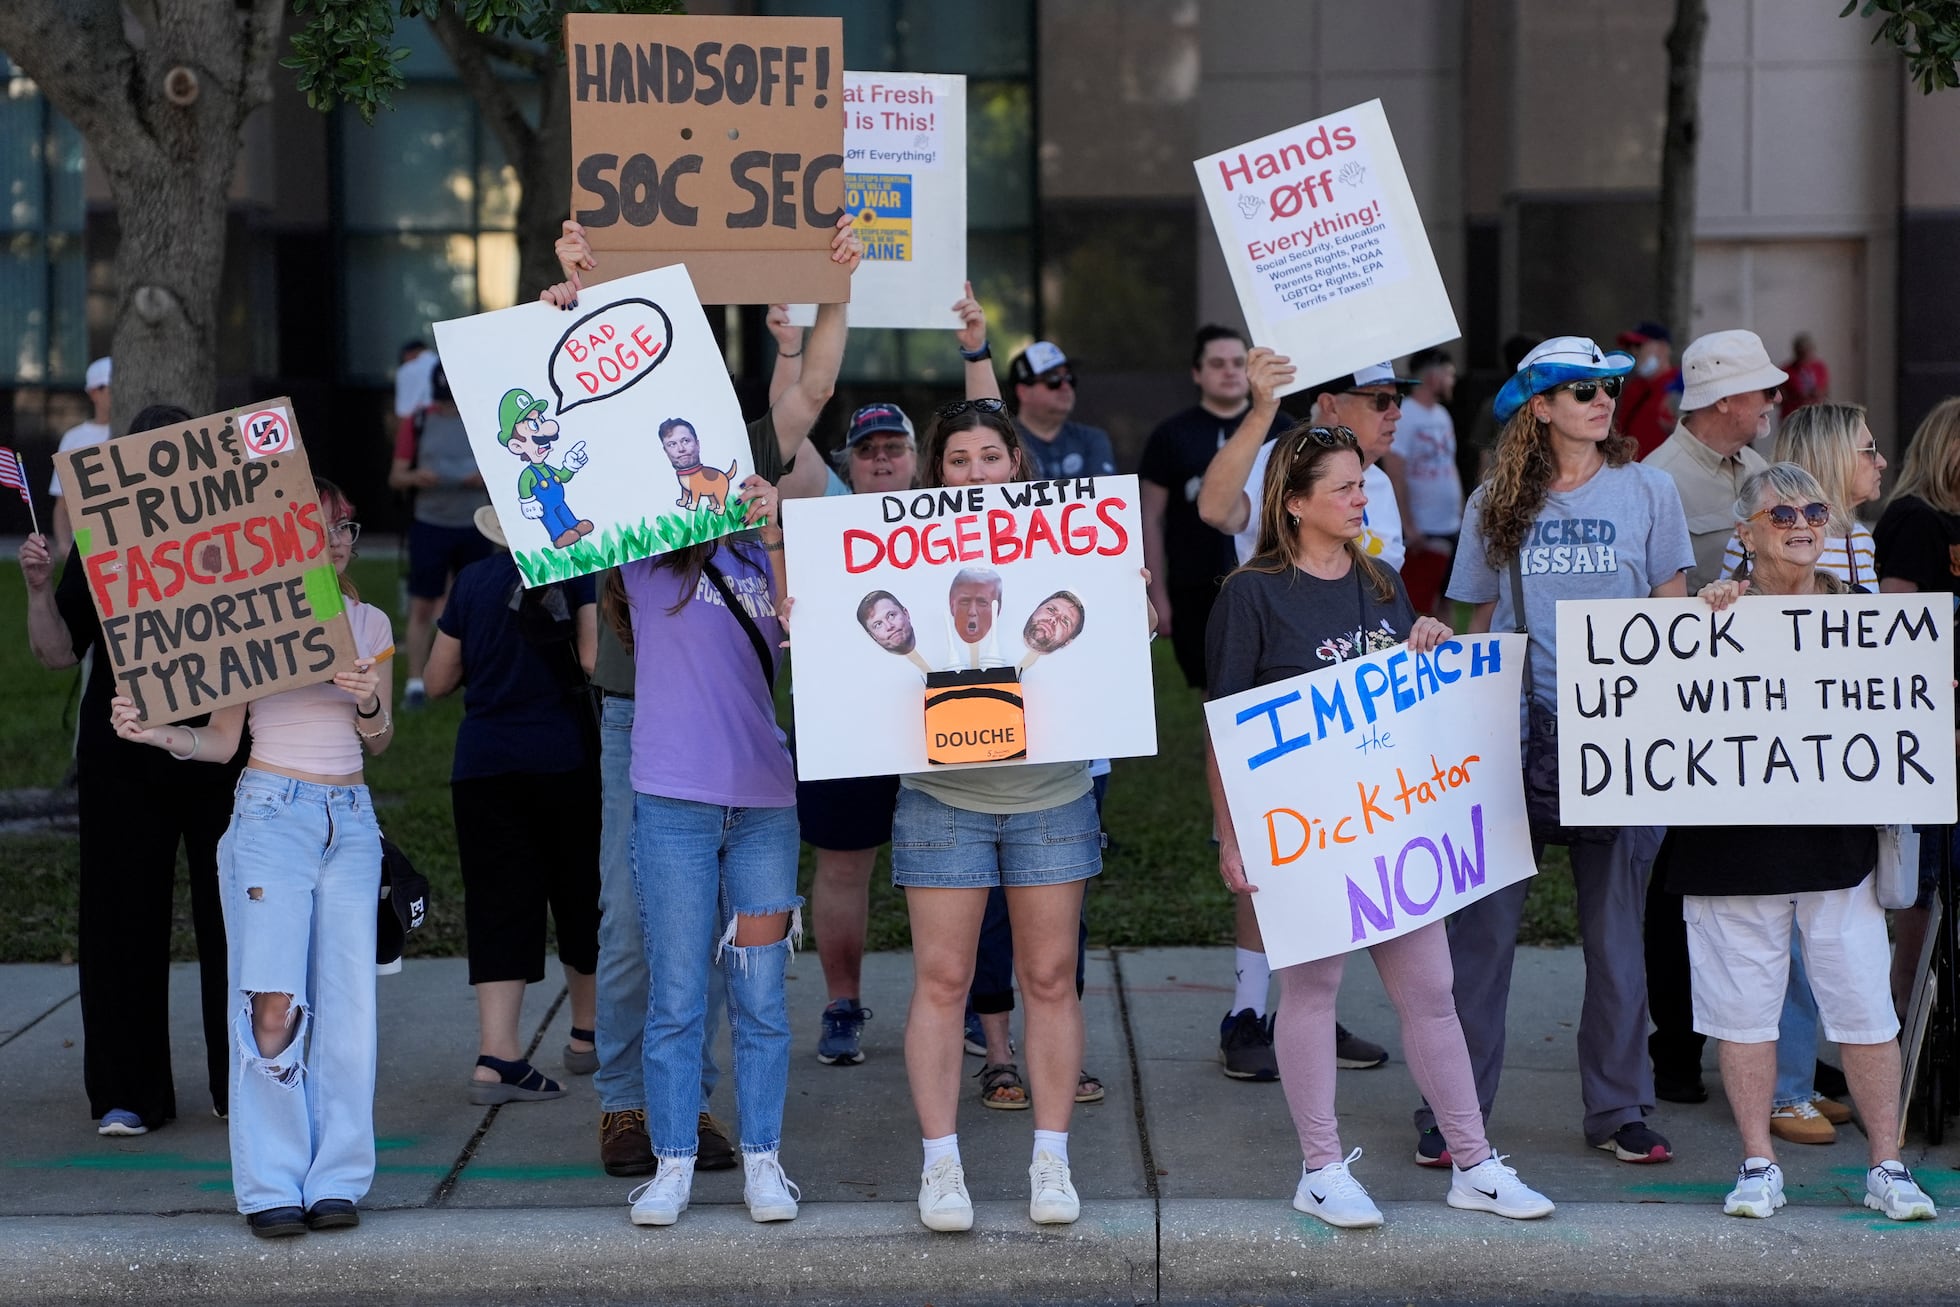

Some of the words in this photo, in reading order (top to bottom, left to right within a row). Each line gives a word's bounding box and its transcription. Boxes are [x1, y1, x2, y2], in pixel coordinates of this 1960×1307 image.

[843, 85, 864, 103] at
[871, 84, 934, 104] Fresh
[856, 111, 873, 130] is
[881, 112, 935, 131] This!
[870, 150, 936, 163] Everything!
[1218, 125, 1357, 192] Hands
[576, 153, 703, 228] SOC
[726, 150, 846, 229] SEC
[846, 190, 860, 208] O
[863, 190, 901, 208] WAR
[1247, 200, 1382, 261] Everything!
[1256, 254, 1288, 273] Social
[1288, 242, 1334, 262] Security,
[1334, 223, 1386, 246] Education
[1269, 262, 1313, 281] Womens
[1313, 248, 1350, 266] Rights,
[1350, 237, 1380, 253] Parks
[1274, 274, 1313, 292] Parents
[1314, 261, 1351, 279] Rights,
[1351, 248, 1383, 265] NOAA
[1281, 283, 1323, 303] LGBTQ+
[1325, 270, 1361, 288] Rights,
[1362, 261, 1384, 275] EPA
[1337, 276, 1374, 296] Taxes!!
[564, 324, 615, 363] BAD
[576, 324, 663, 394] DOGE
[70, 428, 217, 500] ELON
[882, 487, 984, 523] DONE
[1001, 477, 1096, 509] WITH
[843, 497, 1128, 574] DOGEBAGS
[1521, 518, 1617, 547] ICKED
[86, 502, 326, 618] FASCISM'S
[1520, 545, 1619, 576] ISSAH
[103, 577, 311, 667] FAVORITE
[1587, 610, 1744, 666] LOCK
[1782, 607, 1939, 651] THEM
[119, 627, 335, 721] TYRANTS
[1575, 675, 1638, 718] UP
[1677, 675, 1787, 713] WITH
[1814, 674, 1935, 711] THEIR
[1236, 640, 1501, 771] IMPEACH
[935, 727, 1015, 748] DOUCHE
[1355, 724, 1396, 755] the
[1581, 730, 1935, 797] DICKTATOR
[1345, 803, 1486, 943] NOW
